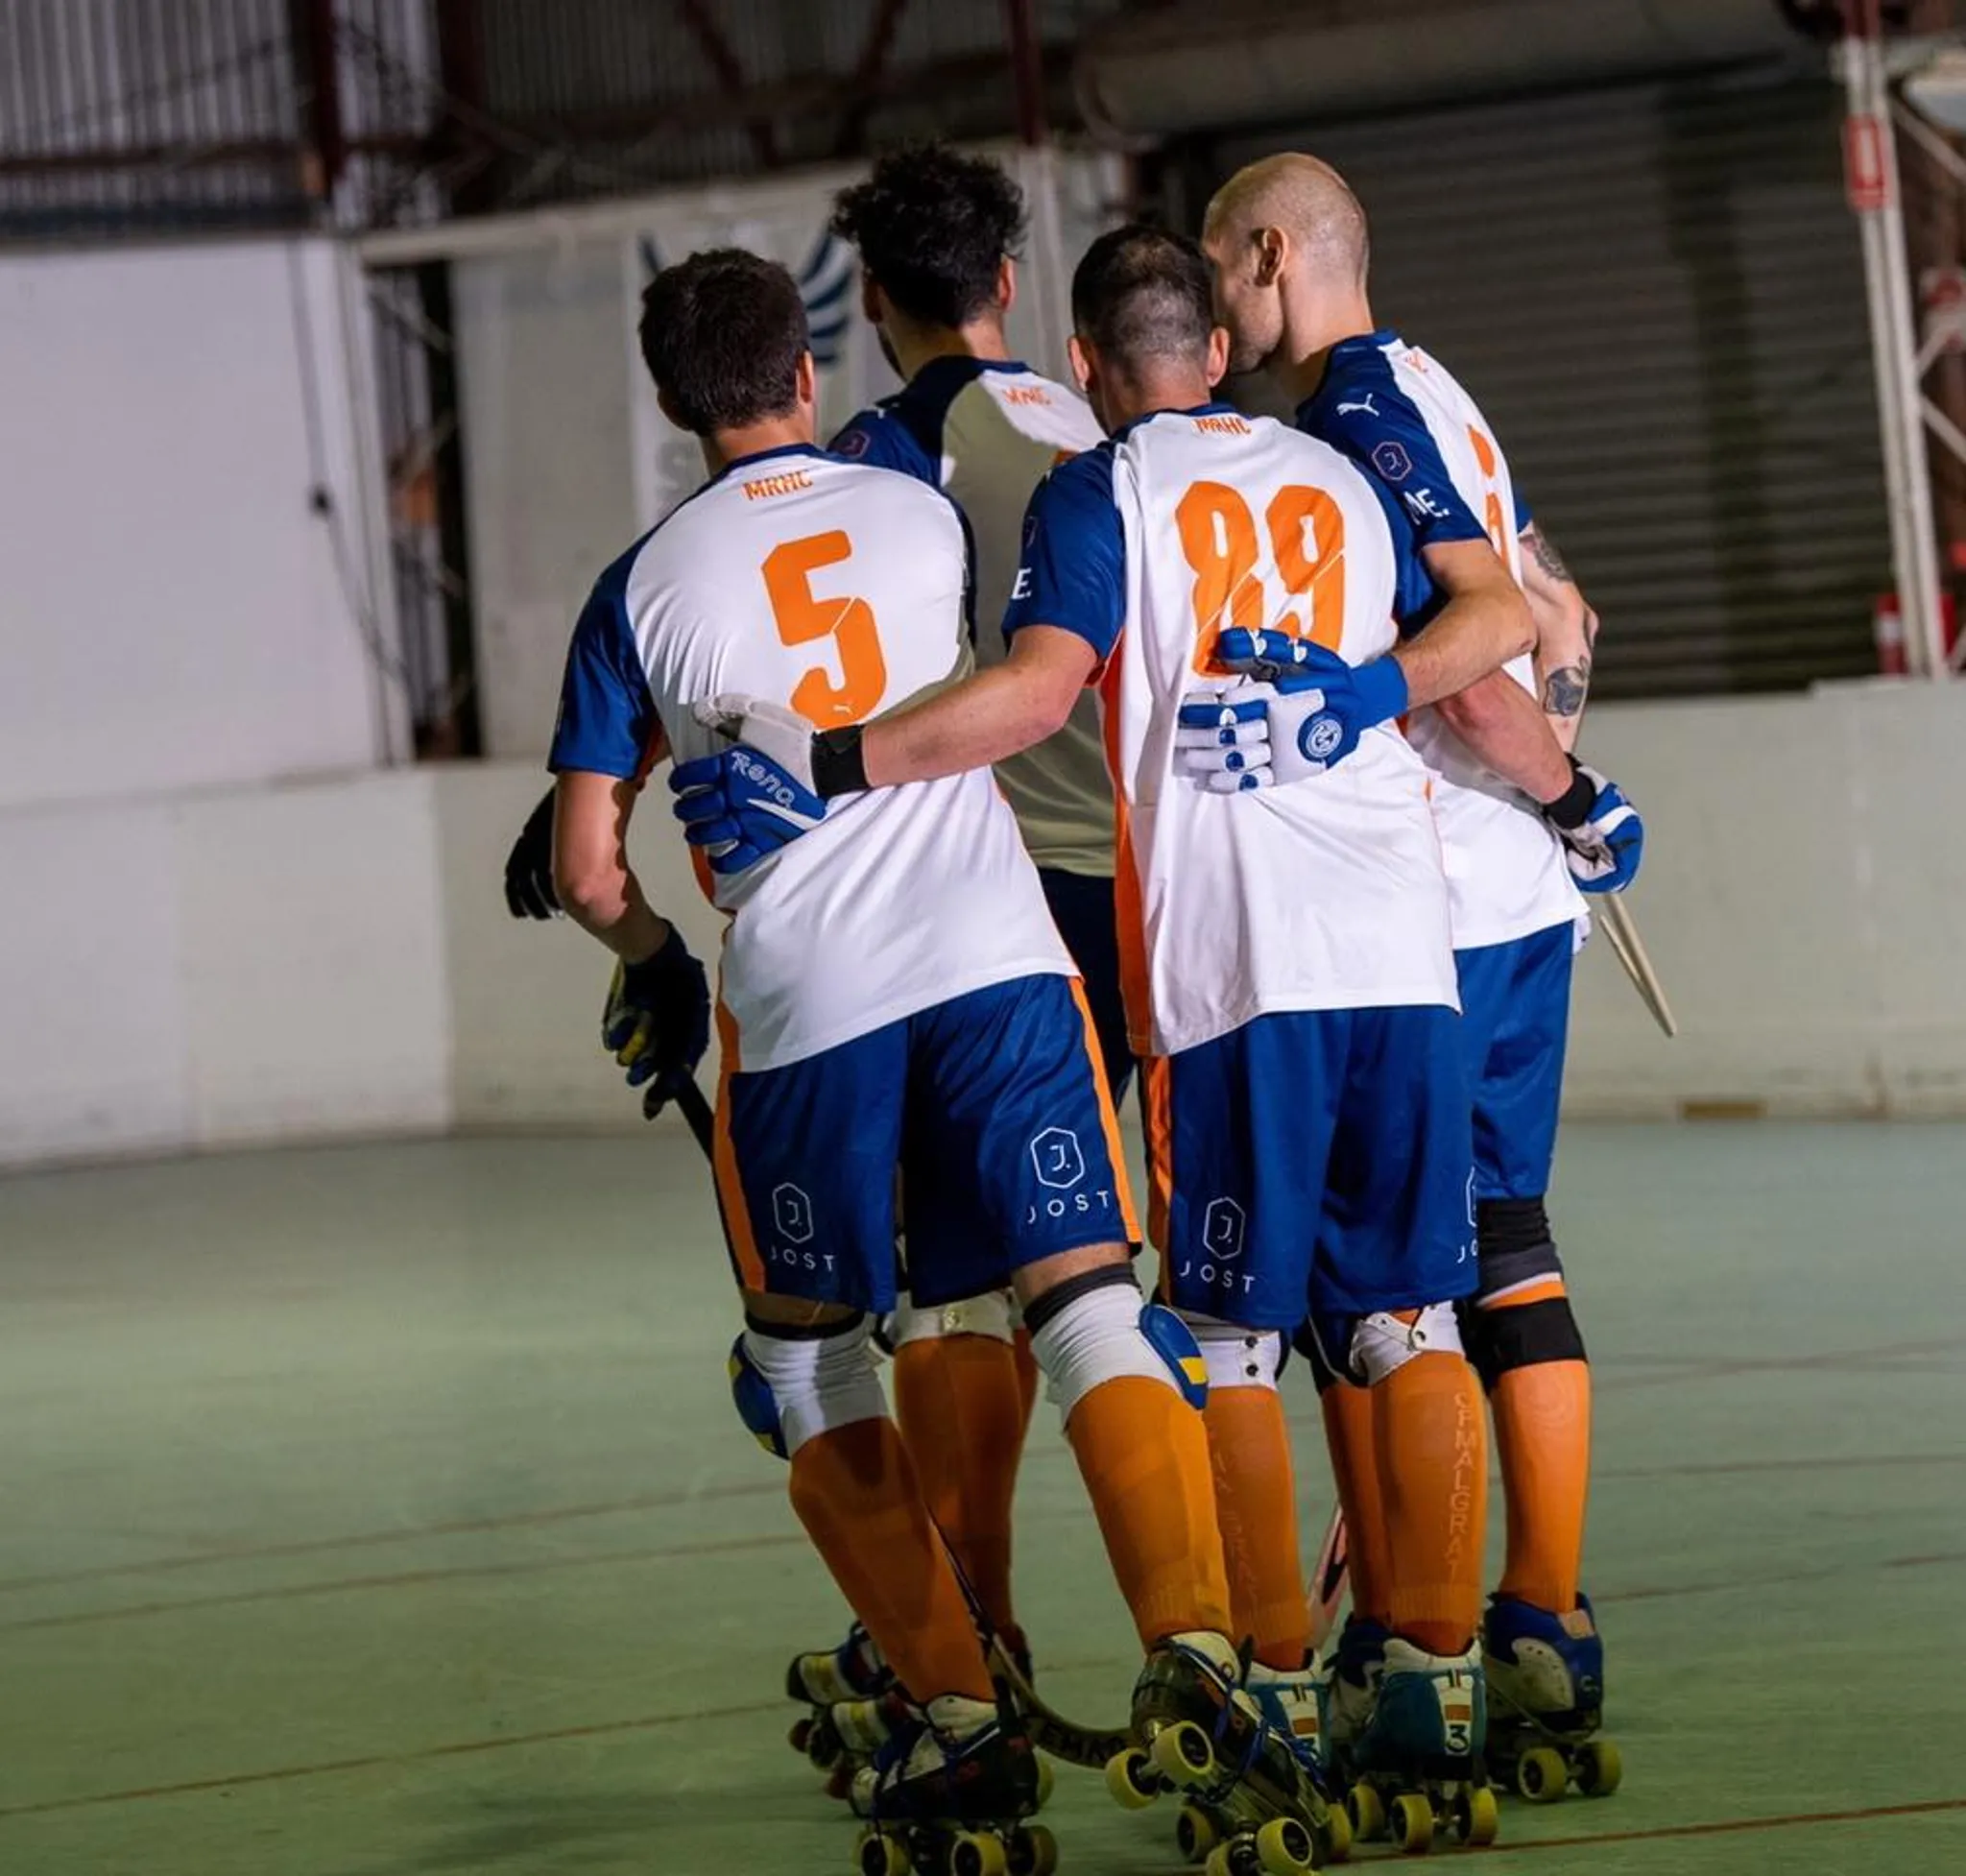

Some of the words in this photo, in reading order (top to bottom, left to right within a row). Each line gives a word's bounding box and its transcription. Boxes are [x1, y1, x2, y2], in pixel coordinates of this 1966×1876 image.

[742, 469, 813, 502] MRHC
[1175, 480, 1346, 679] 89
[760, 528, 888, 732] 5
[1027, 1190, 1111, 1224] JOST
[770, 1247, 837, 1273] JOST
[1179, 1261, 1257, 1295] JOST
